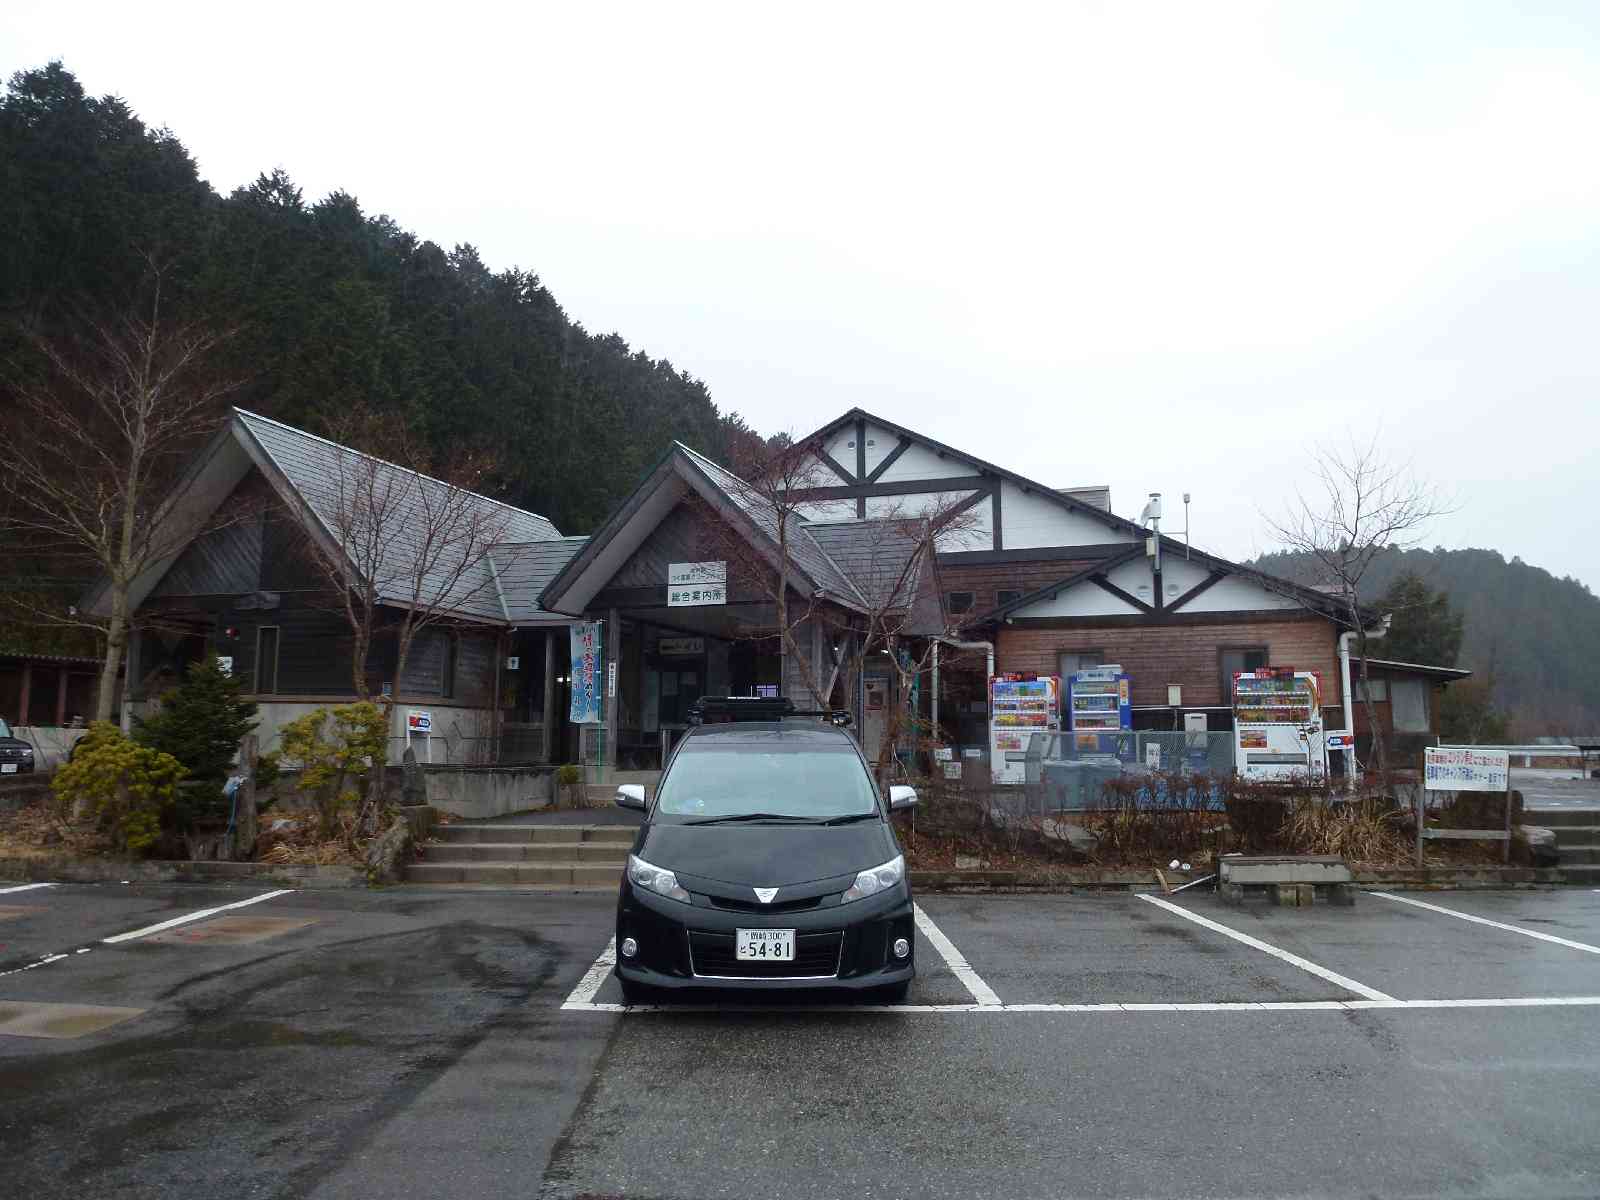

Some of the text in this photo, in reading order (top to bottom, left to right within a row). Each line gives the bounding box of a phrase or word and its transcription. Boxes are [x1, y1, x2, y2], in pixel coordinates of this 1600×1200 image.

[672, 591, 722, 602] 総合案内所
[767, 931, 783, 940] 300
[749, 942, 790, 958] 54-81
